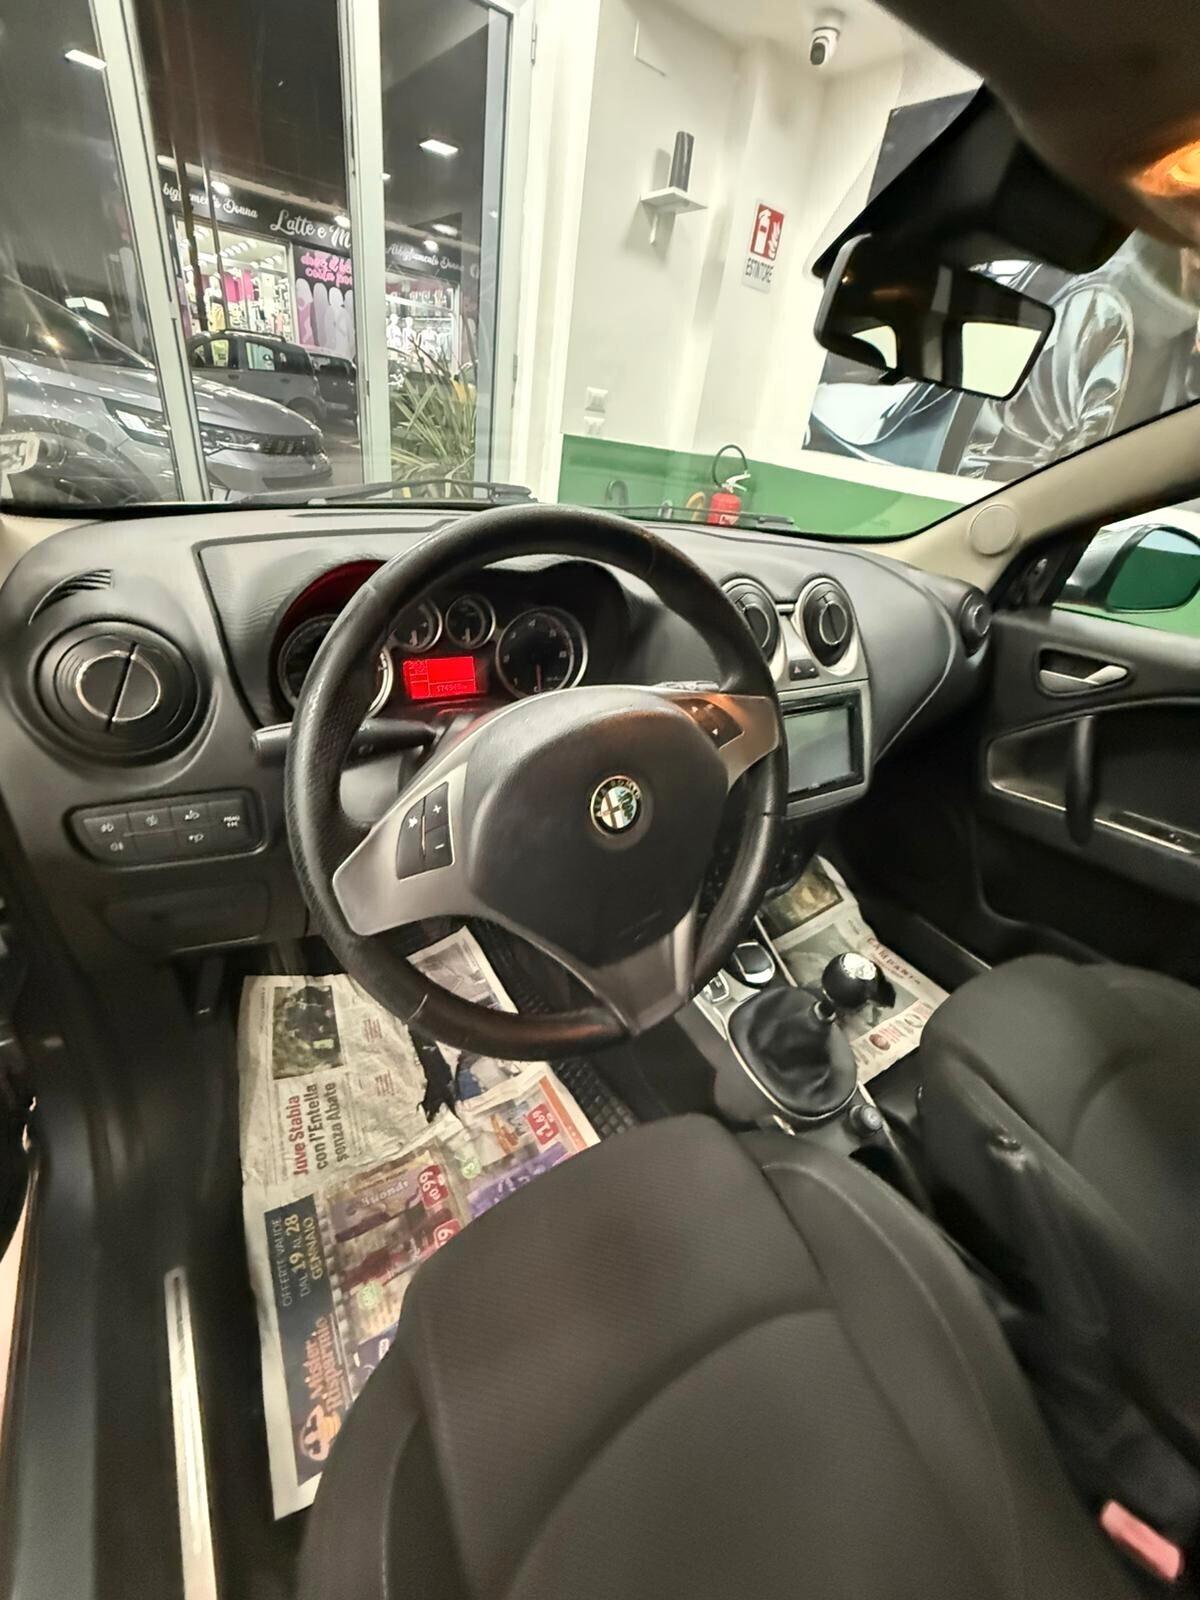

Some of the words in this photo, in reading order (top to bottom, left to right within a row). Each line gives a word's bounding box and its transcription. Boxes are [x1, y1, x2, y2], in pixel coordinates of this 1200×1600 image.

[270, 209, 316, 235] Latte
[317, 227, 327, 238] e
[285, 1095, 305, 1142] Stabia
[303, 1083, 325, 1142] l'Entella
[324, 1082, 342, 1121] Abate
[293, 1142, 309, 1176] Juve
[314, 1142, 329, 1170] con
[284, 1214, 300, 1237] 28
[289, 1252, 306, 1273] 19
[303, 1216, 323, 1280] GENNAIO
[275, 1260, 293, 1307] OFFERTE
